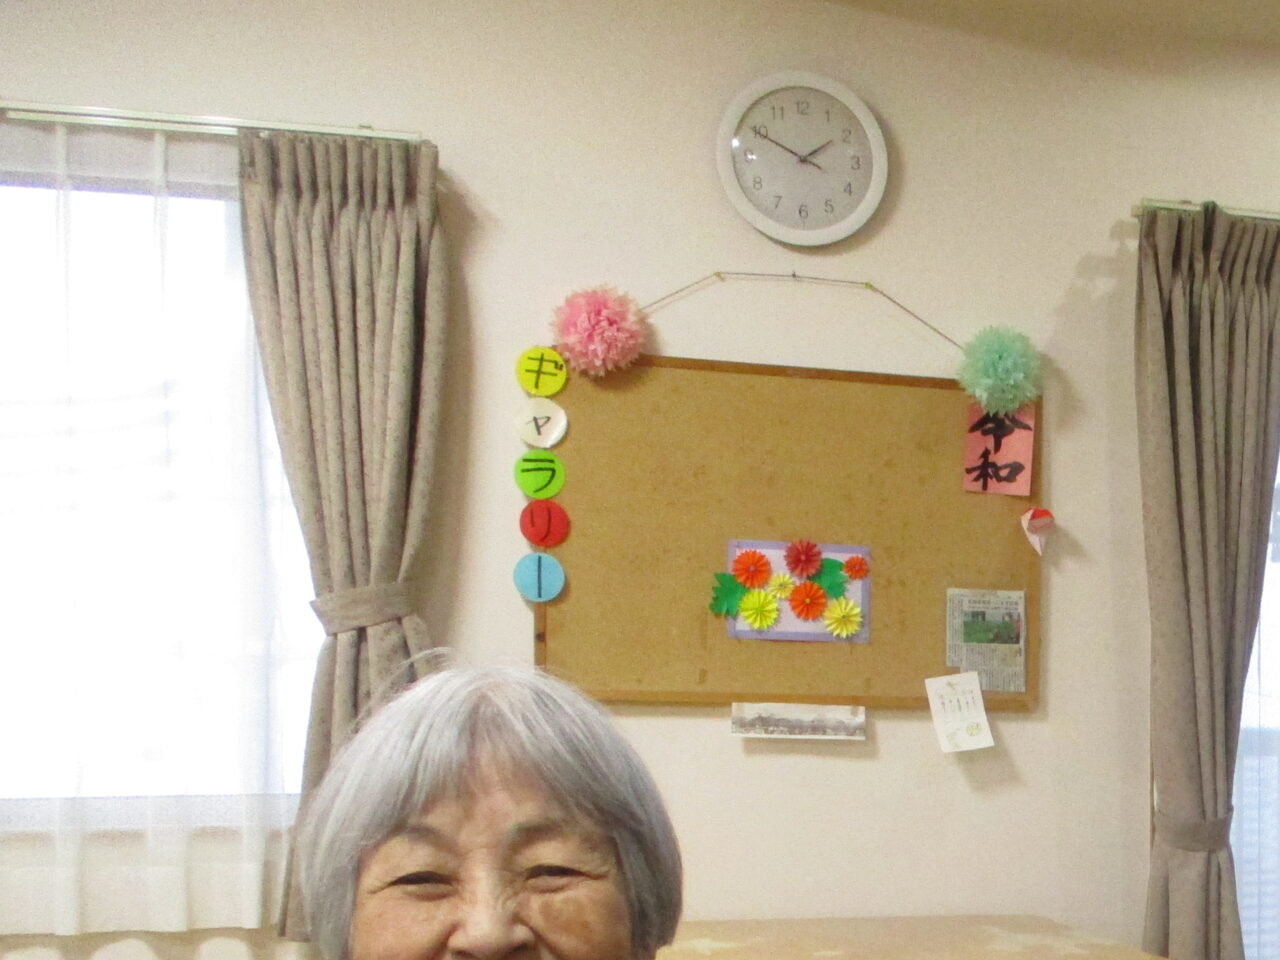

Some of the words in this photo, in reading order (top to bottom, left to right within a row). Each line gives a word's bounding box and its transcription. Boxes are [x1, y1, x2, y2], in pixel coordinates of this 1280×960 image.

[770, 105, 785, 121] 11
[795, 100, 810, 116] 12
[824, 109, 831, 123] 1
[842, 128, 852, 144] 2
[850, 155, 861, 170] 3
[752, 176, 763, 191] 8
[843, 182, 852, 197] 4
[772, 194, 782, 209] 7
[824, 198, 835, 214] 5
[798, 204, 809, 220] 6
[965, 411, 1033, 491] 令和
[521, 352, 564, 599] ギャラリー
